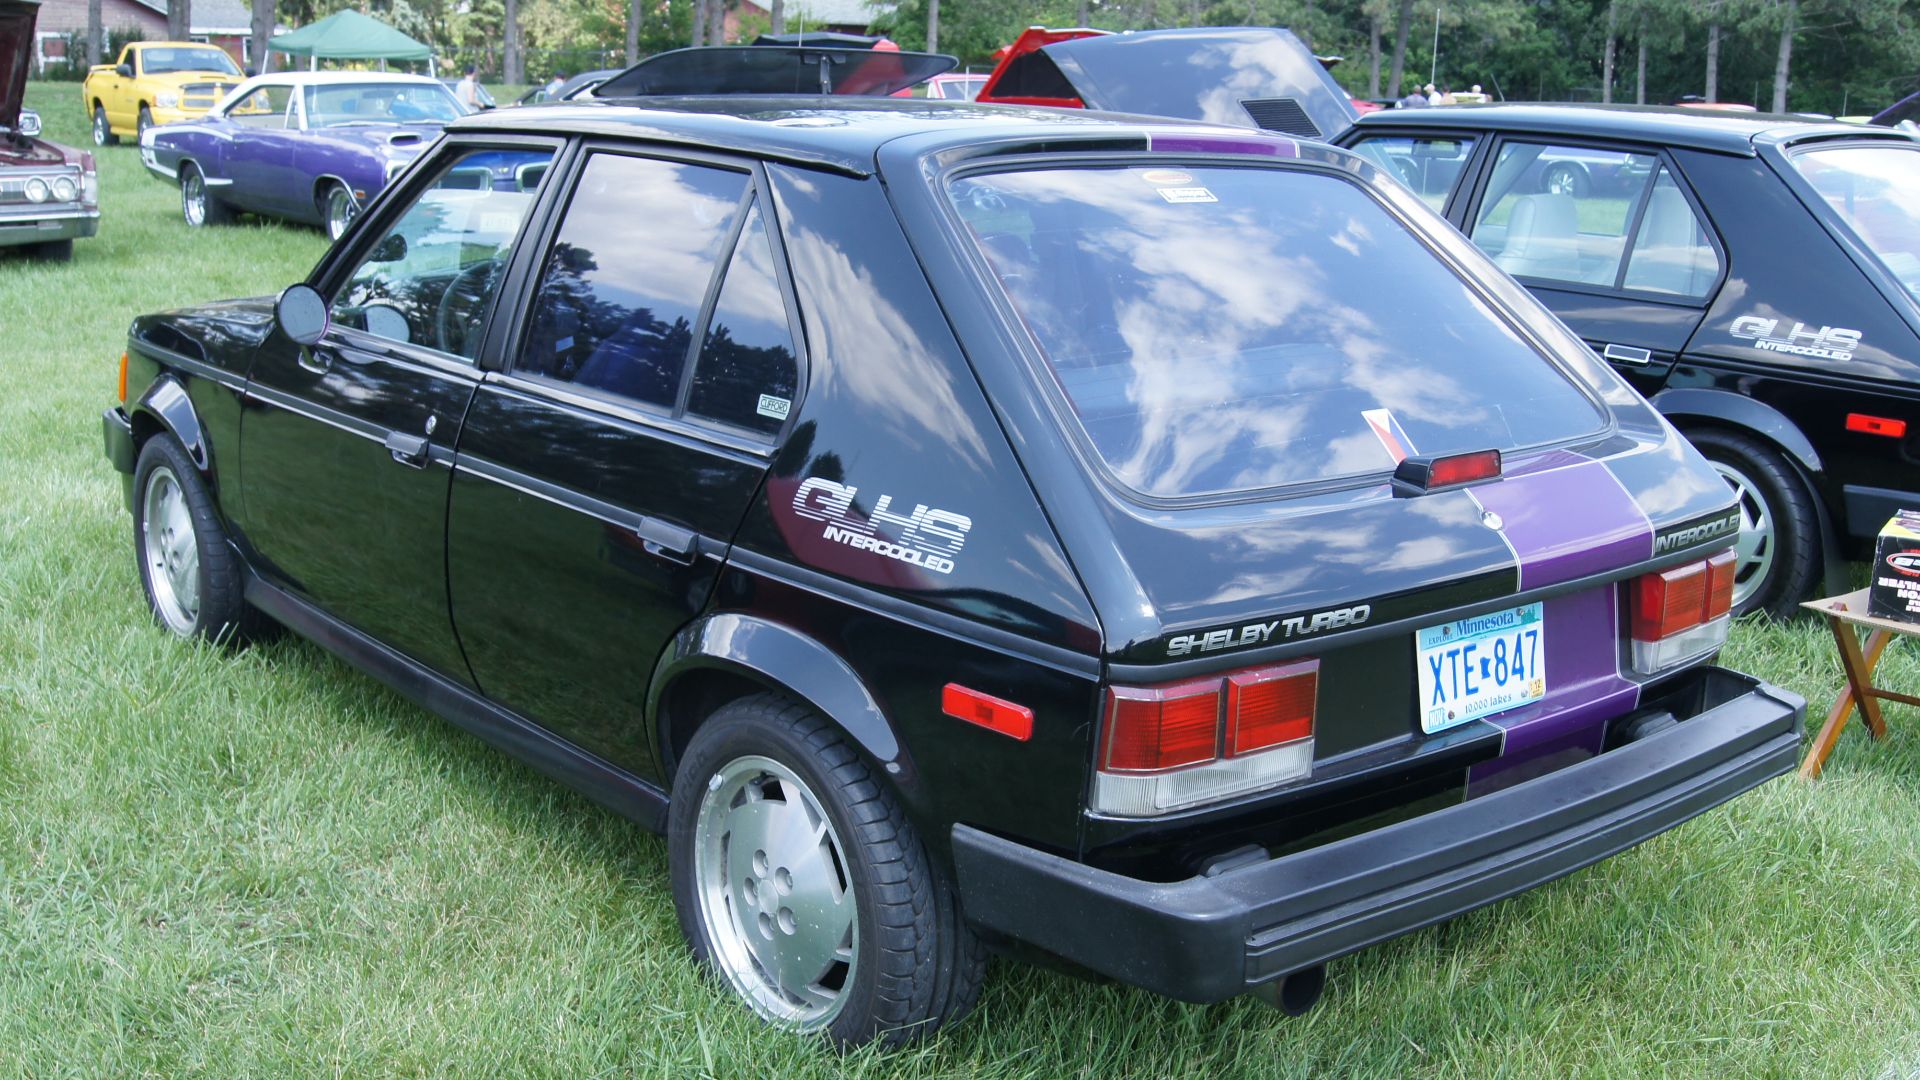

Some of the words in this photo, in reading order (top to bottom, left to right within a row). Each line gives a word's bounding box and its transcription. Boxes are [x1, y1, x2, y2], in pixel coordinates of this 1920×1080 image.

[1729, 315, 1862, 352] GLHS
[1754, 340, 1852, 361] INTERCOOLED
[792, 476, 972, 557] GLHS
[822, 525, 954, 574] INTERCOOLED
[1166, 621, 1279, 657] SHELBY
[1282, 604, 1371, 637] TURBO
[1456, 612, 1514, 637] Minnesota
[1428, 643, 1479, 706] XTE
[1493, 629, 1538, 687] 847
[1465, 700, 1488, 714] 10,000
[1490, 693, 1512, 708] lakes
